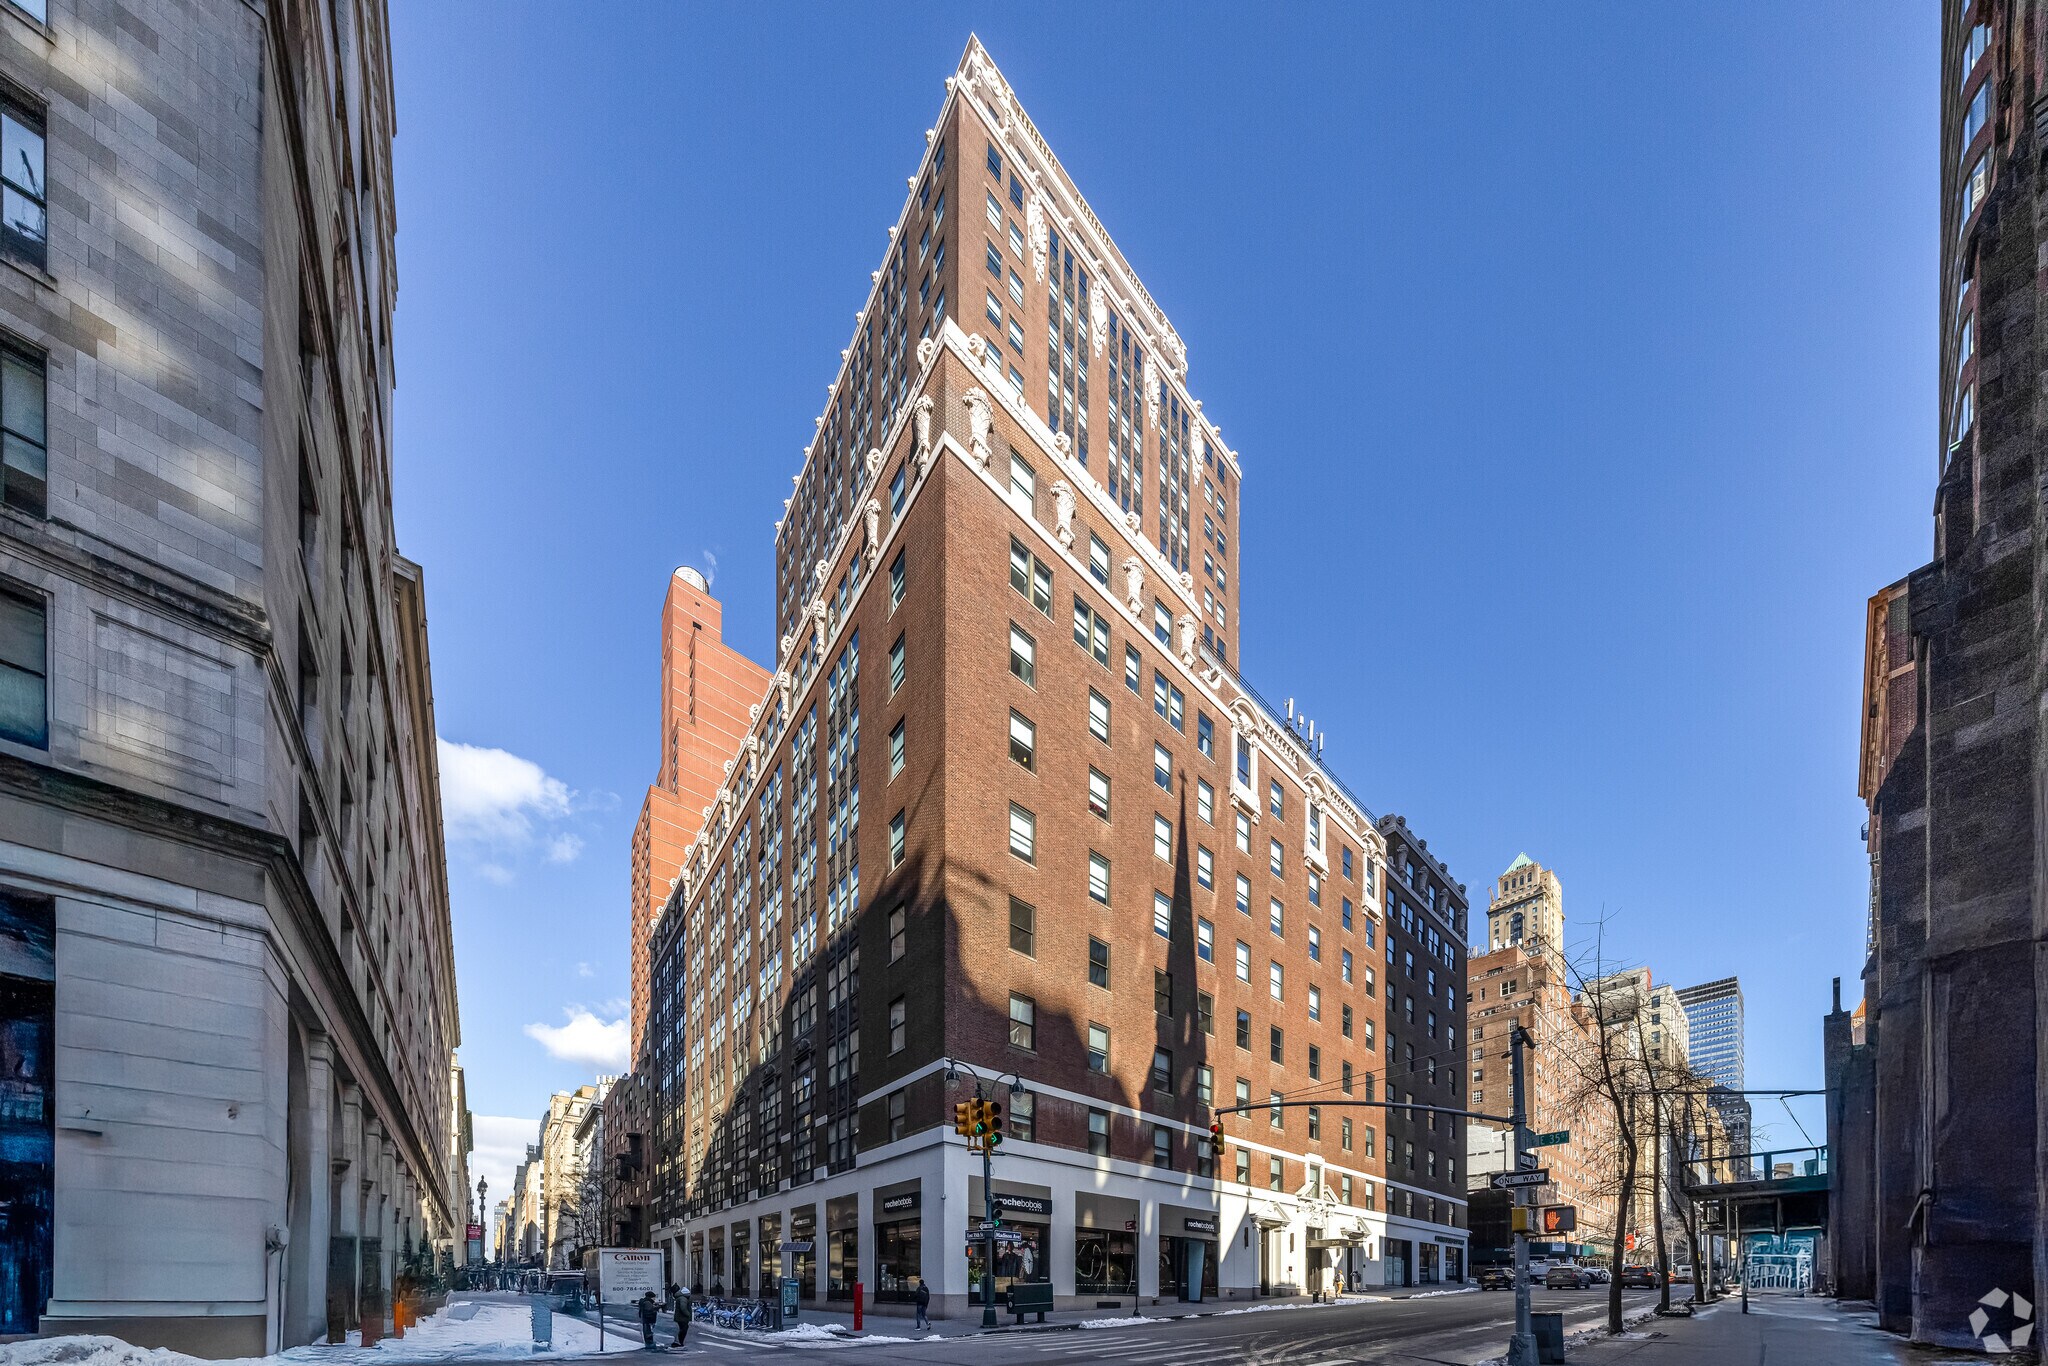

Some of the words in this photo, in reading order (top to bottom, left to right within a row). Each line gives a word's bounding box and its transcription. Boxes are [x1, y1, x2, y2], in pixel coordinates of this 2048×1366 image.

[1540, 1136, 1546, 1145] E
[1499, 1177, 1515, 1185] ONE
[1522, 1174, 1541, 1182] WAY
